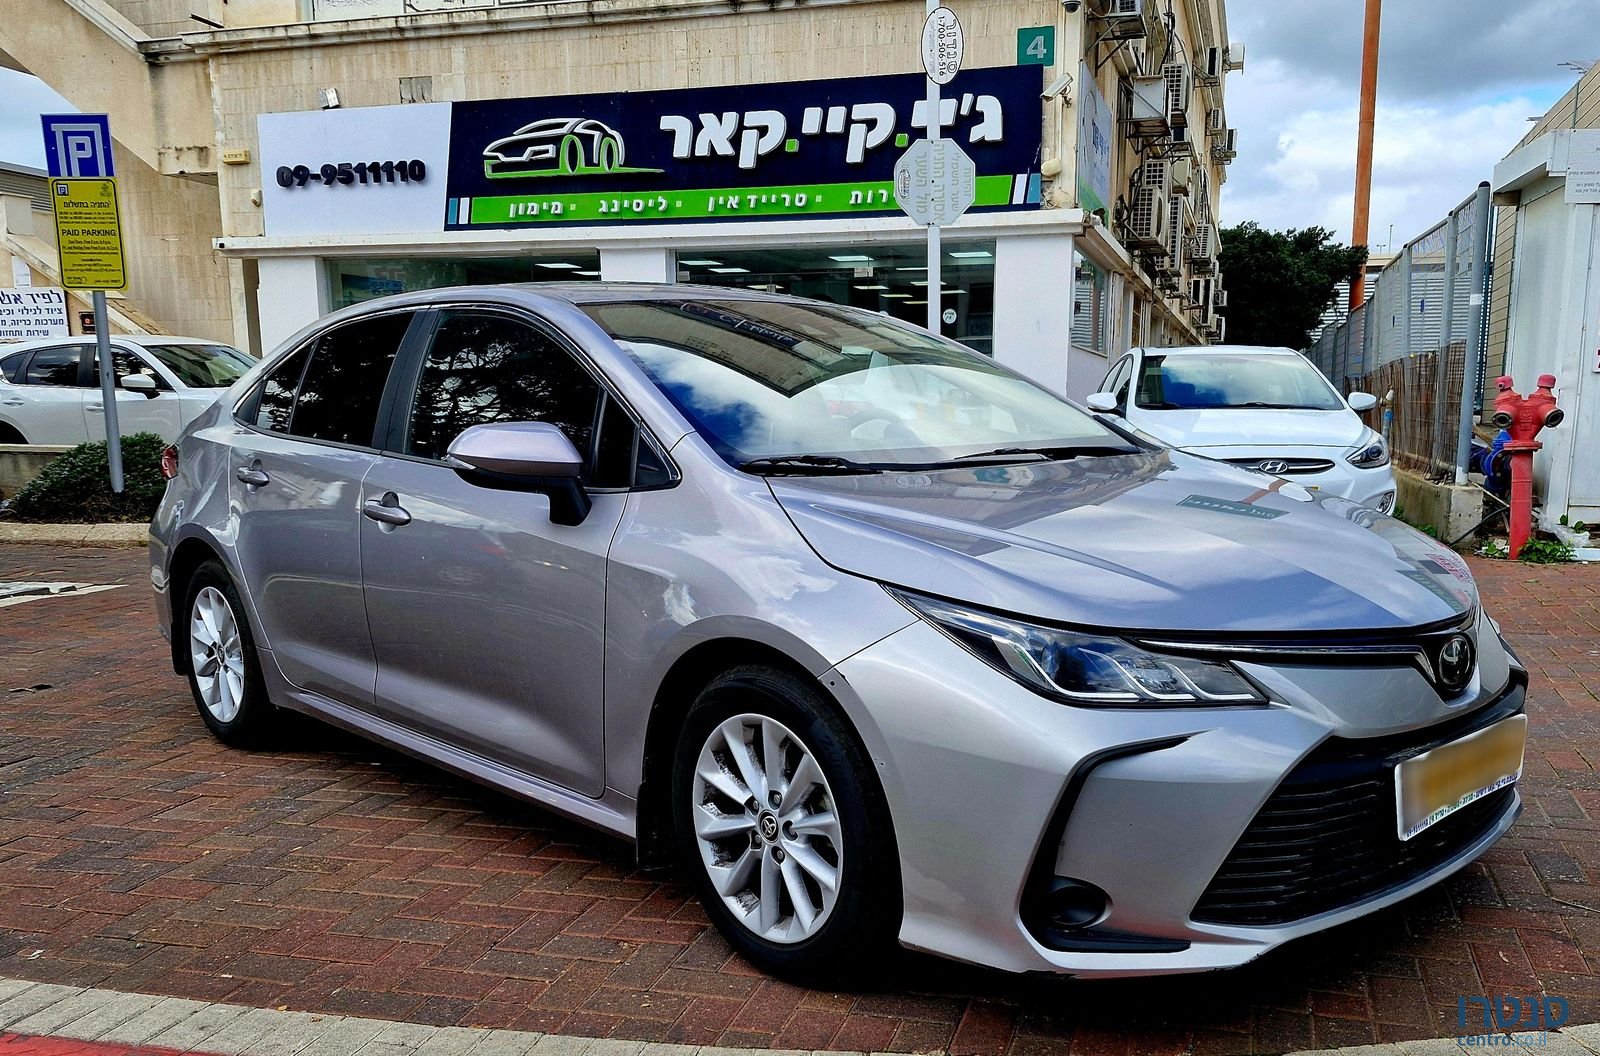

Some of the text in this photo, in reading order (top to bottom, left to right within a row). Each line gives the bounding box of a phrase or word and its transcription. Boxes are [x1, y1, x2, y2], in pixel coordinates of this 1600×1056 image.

[938, 15, 946, 77] 1-700-506-516
[946, 18, 958, 74] סנדור
[1026, 35, 1047, 59] 4
[276, 159, 426, 188] 09-9511110
[933, 143, 945, 221] אסורה החניה
[951, 152, 961, 212] שער חשמלי
[963, 167, 972, 197] זהירות
[915, 152, 931, 214] מול השער
[63, 200, 89, 208] בתשלום
[509, 201, 564, 218] מימון
[599, 195, 668, 213] ליסינג
[708, 195, 740, 212] אין
[747, 193, 808, 208] טרייד
[25, 290, 63, 304] לפיד
[45, 307, 63, 315] ציוד
[34, 318, 64, 326] מערכות
[26, 329, 49, 337] שירות
